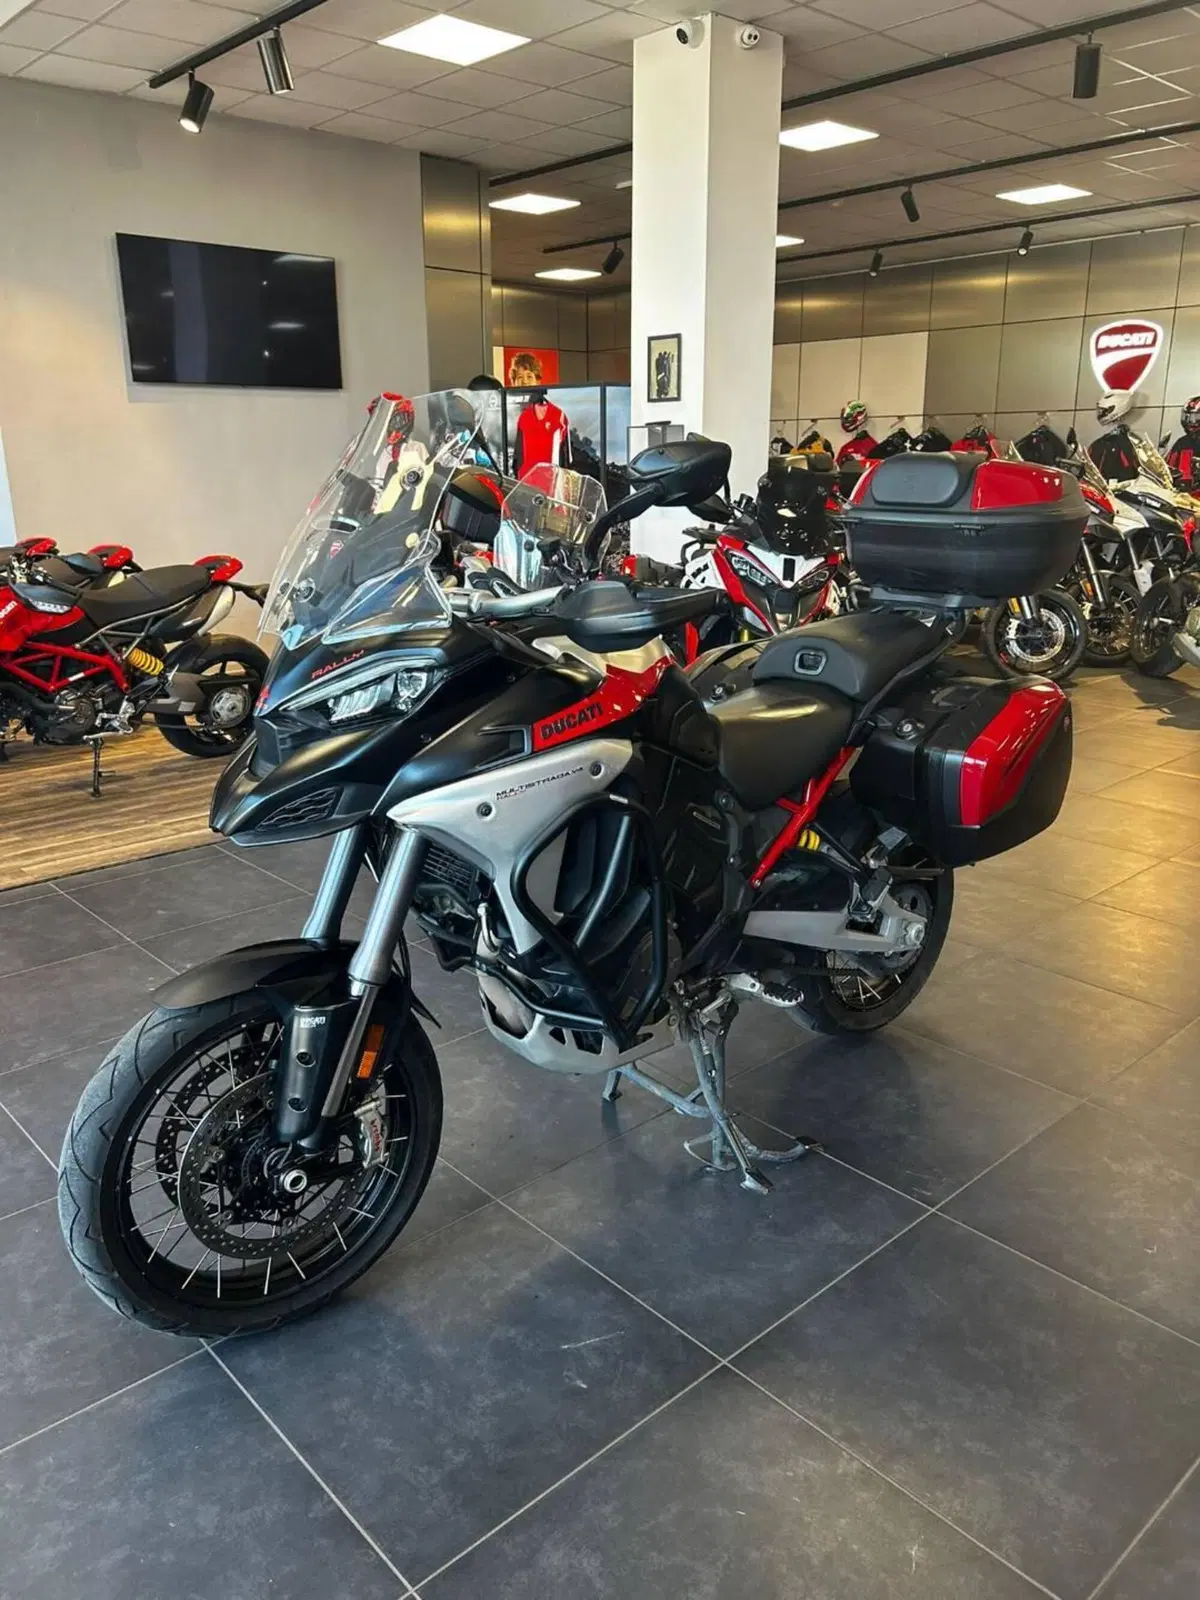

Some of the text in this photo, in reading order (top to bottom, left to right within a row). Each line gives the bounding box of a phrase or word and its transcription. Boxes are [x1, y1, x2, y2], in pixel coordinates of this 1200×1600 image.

[1098, 332, 1155, 349] DUCATI
[312, 649, 364, 678] RALLY
[540, 702, 604, 740] DUCATI
[496, 771, 571, 797] MULTISTRADA
